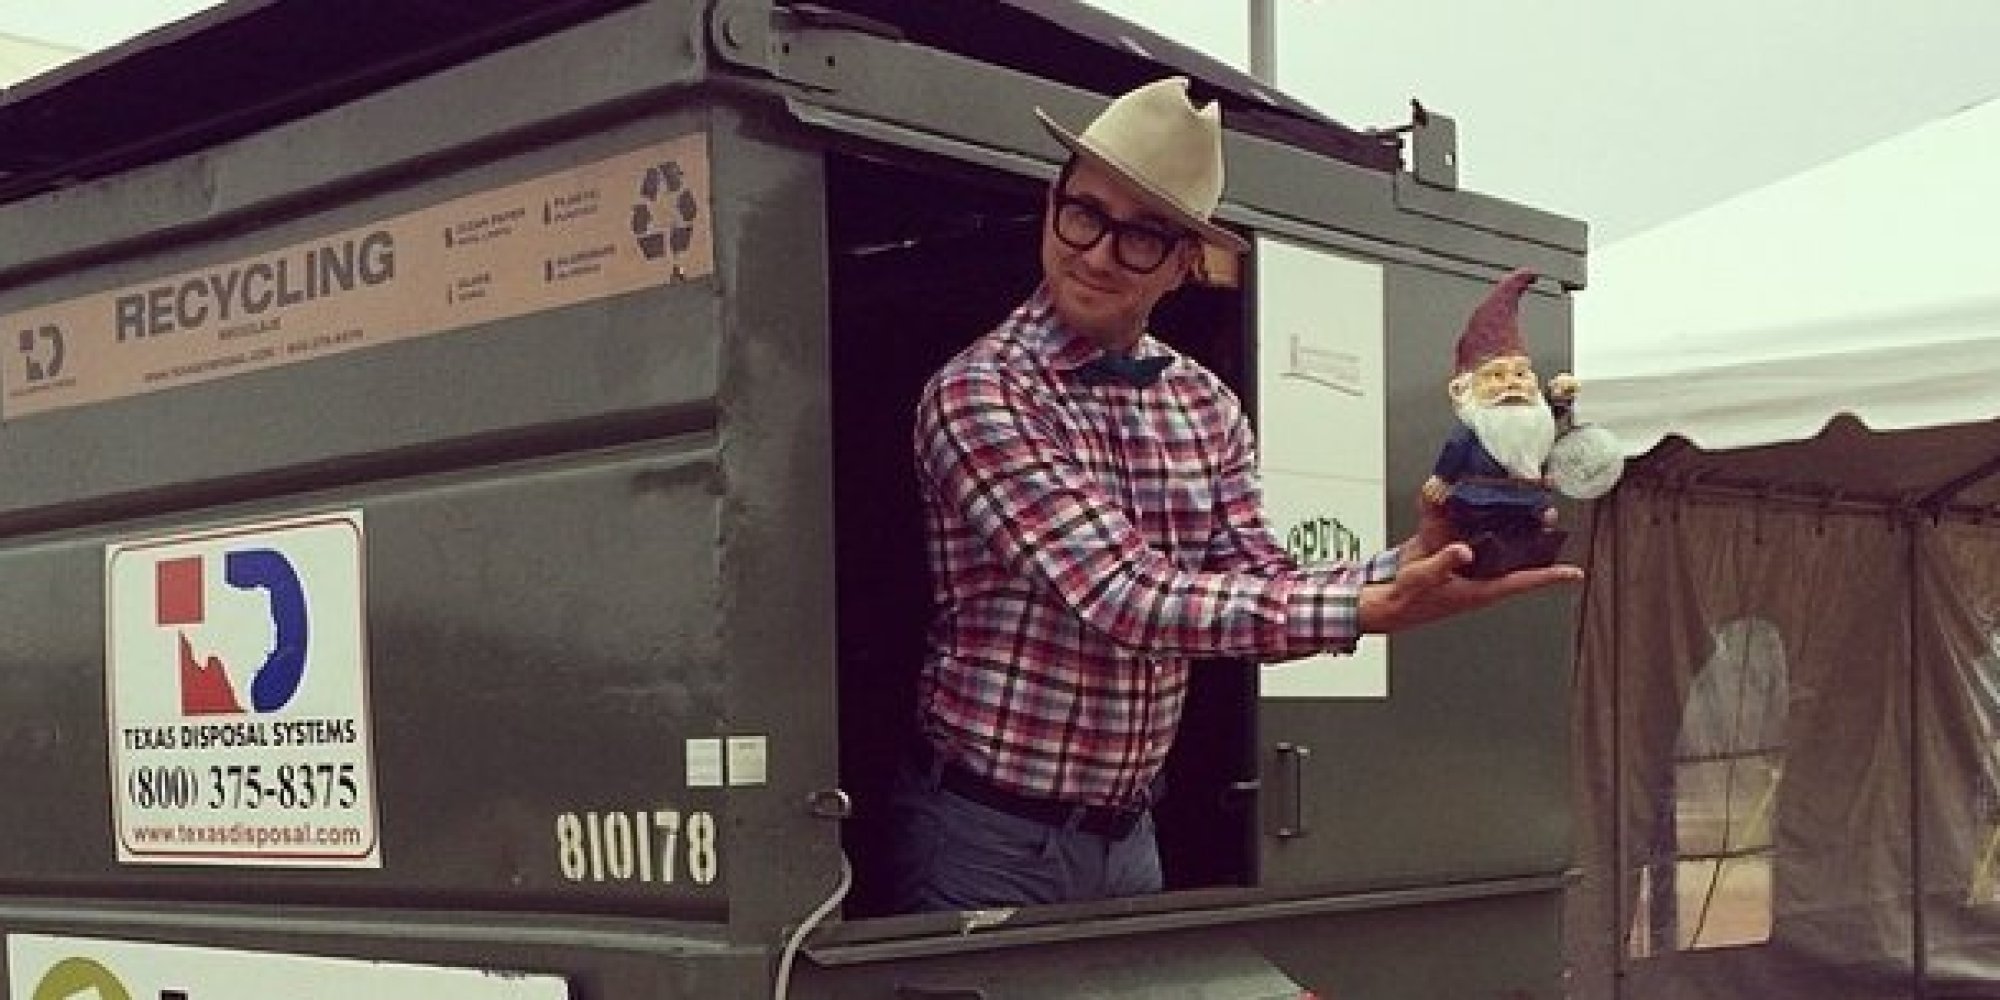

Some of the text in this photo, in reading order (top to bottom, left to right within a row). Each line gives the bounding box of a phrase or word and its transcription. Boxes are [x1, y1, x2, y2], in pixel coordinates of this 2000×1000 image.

[115, 230, 395, 343] RECYCLING
[123, 719, 357, 750] TEXAS DISPOSAL SYSTEMS
[128, 762, 357, 810] (800) 375-8375
[131, 822, 362, 847] www.texasdisposal.com
[557, 811, 718, 885] 810178
